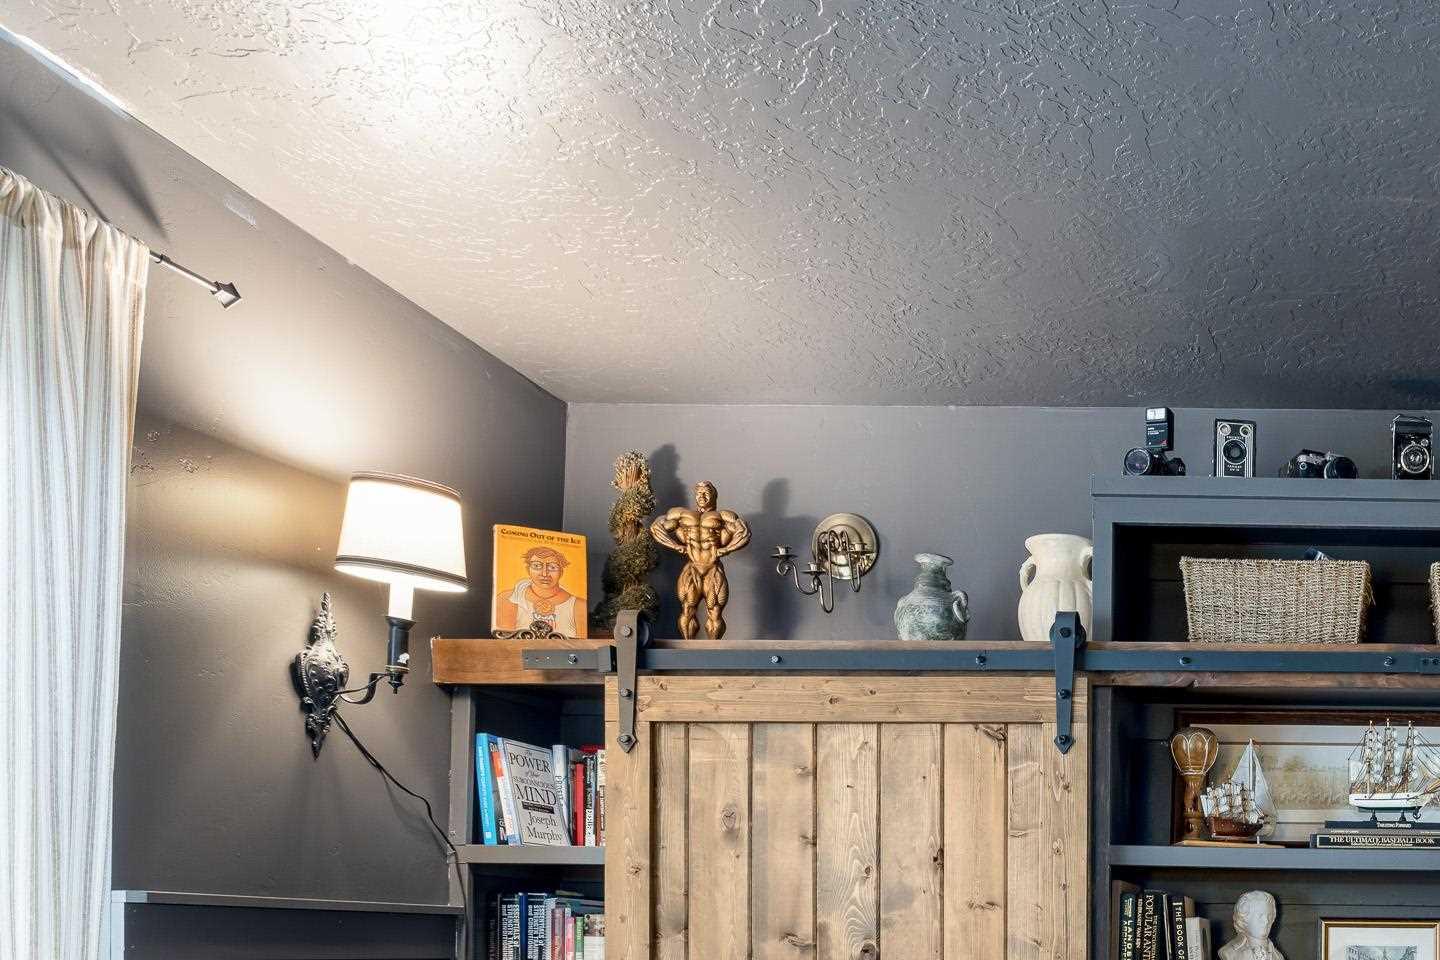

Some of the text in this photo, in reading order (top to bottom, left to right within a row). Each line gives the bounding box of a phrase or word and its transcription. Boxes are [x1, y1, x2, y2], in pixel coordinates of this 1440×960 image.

[509, 752, 551, 773] POWER
[513, 783, 557, 806] MIND
[527, 811, 558, 829] Joseph
[526, 826, 562, 844] Murphy
[1329, 835, 1345, 843] THE
[1346, 835, 1380, 844] ULTIMATE
[1381, 836, 1414, 844] BASEBALL
[1416, 836, 1435, 844] BOOK
[1144, 895, 1154, 937] POPULAR
[1175, 907, 1183, 921] THE
[1176, 924, 1184, 947] BOOK
[1178, 950, 1185, 960] OF
